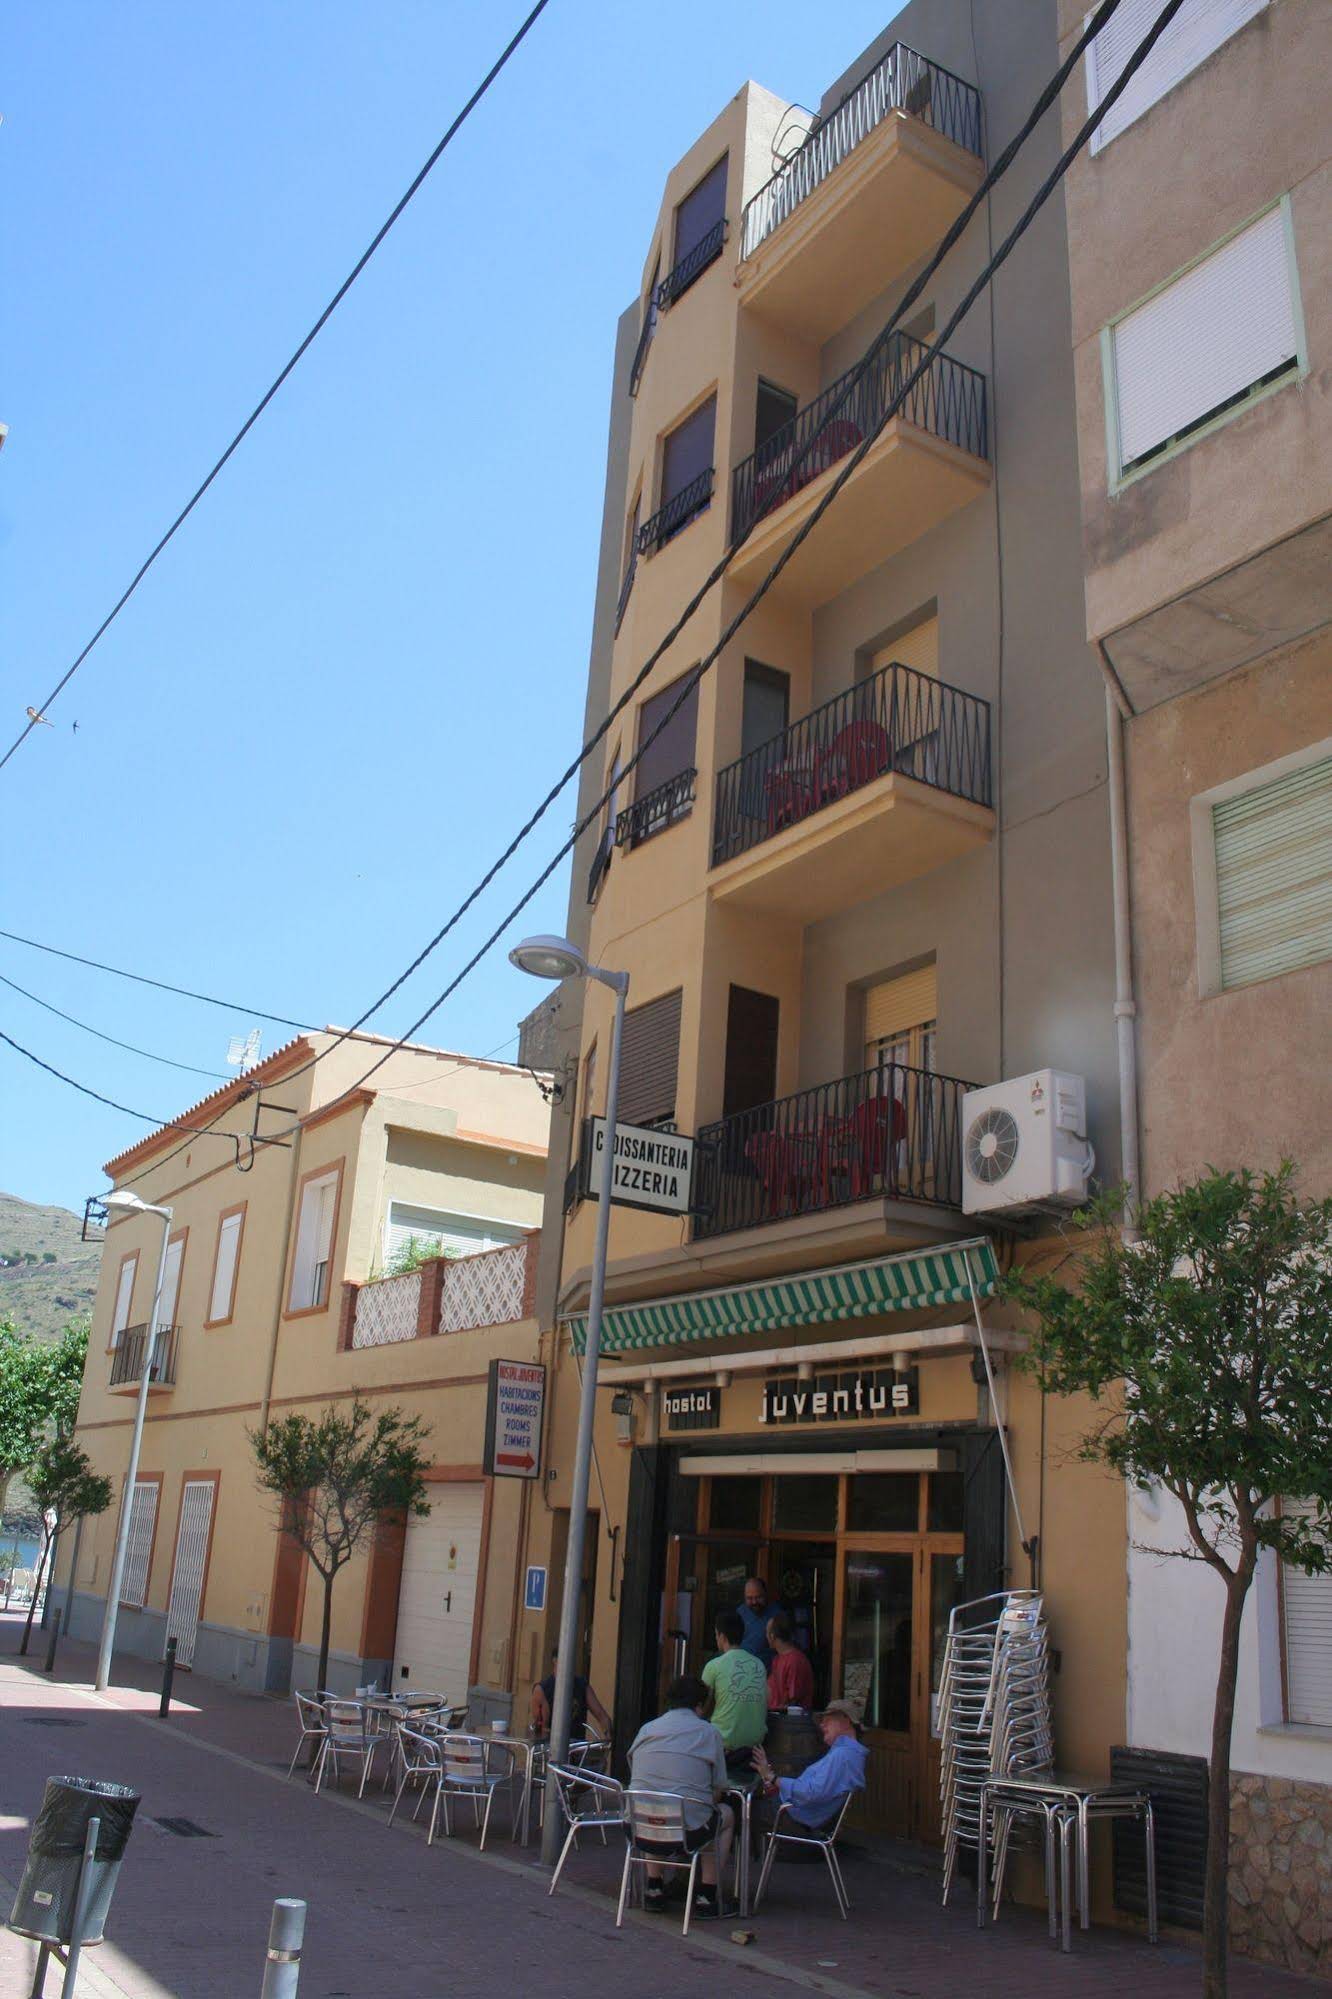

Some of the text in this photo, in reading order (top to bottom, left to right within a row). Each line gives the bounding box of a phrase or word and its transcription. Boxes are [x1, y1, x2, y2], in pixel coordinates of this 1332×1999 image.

[595, 1130, 688, 1171] COISSANTERIA
[613, 1163, 678, 1198] IZZERIA
[500, 1401, 538, 1418] CHAMBRES
[758, 1379, 909, 1423] juventus
[505, 1417, 531, 1432] ROOMS
[503, 1433, 532, 1449] ZIMMER
[532, 1571, 541, 1593] P
